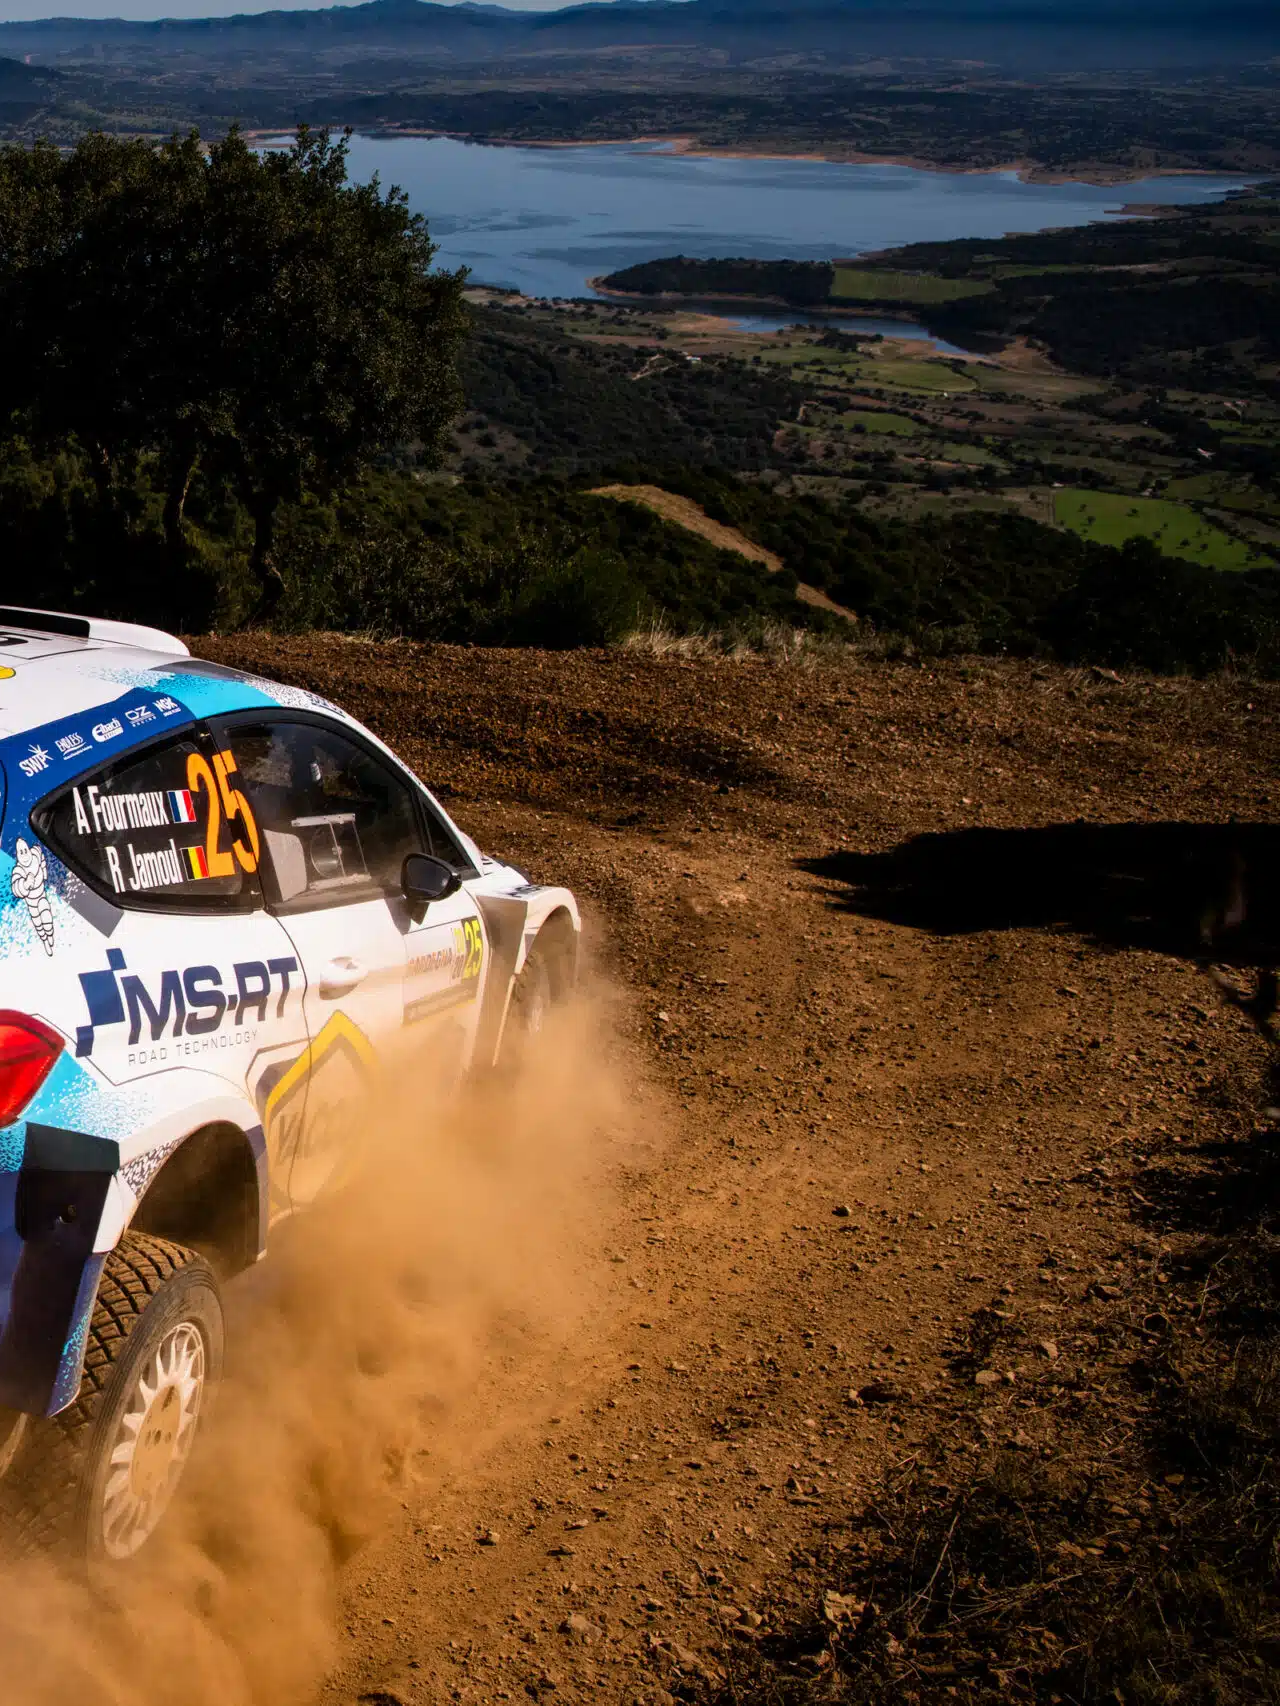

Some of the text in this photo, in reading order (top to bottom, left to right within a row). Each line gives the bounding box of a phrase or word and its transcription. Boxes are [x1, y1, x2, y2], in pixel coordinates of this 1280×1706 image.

[92, 717, 122, 742] Eibach
[125, 705, 151, 720] OZ
[154, 696, 178, 713] NGK
[72, 785, 169, 836] A Fourmaux
[186, 750, 260, 879] 25
[107, 839, 183, 893] R Jamoul
[461, 919, 483, 980] 25
[120, 956, 298, 1046] MS-RT
[128, 1029, 258, 1066] ROAD TECHNOLOGY
